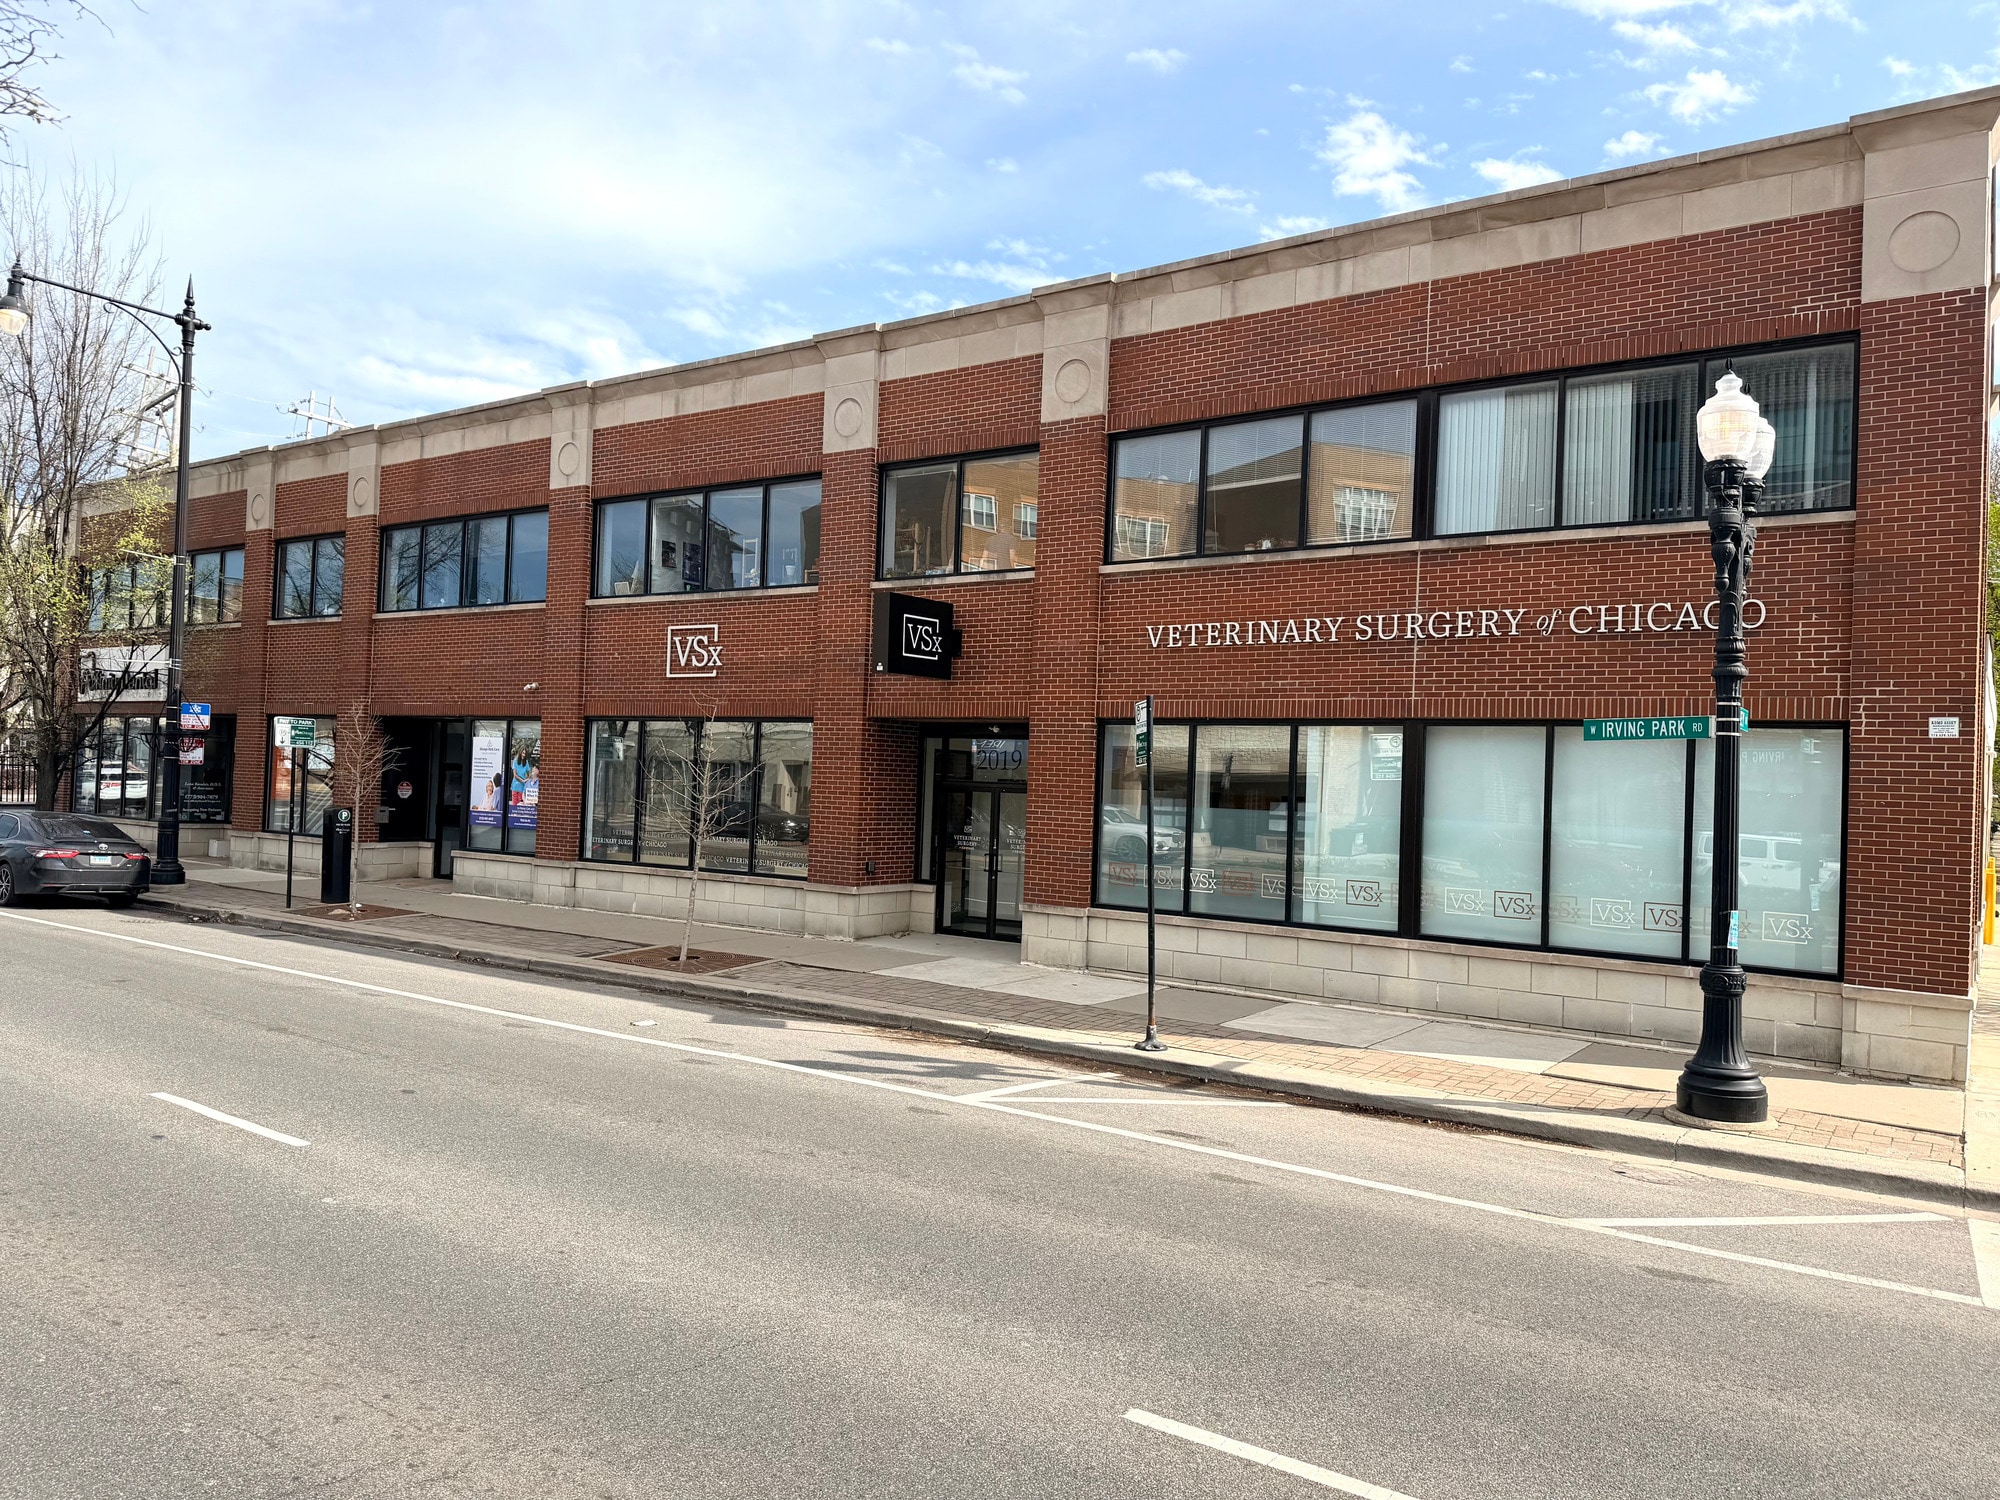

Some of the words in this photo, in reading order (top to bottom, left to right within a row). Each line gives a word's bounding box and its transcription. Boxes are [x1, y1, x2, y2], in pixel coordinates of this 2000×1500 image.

[1146, 617, 1345, 648] VETERINARY
[1355, 609, 1528, 641] SURGERY
[1536, 608, 1562, 636] of
[907, 623, 942, 653] VSx
[673, 635, 724, 667] VSx
[1590, 726, 1597, 734] W
[1602, 721, 1645, 737] IRVING
[1652, 720, 1686, 736] PARK
[1692, 723, 1703, 732] RD
[977, 750, 1022, 770] 2019
[1190, 872, 1217, 889] VSx
[1307, 882, 1338, 899] VSx
[1350, 885, 1383, 902] VSx
[1449, 892, 1486, 911] VSx
[1498, 896, 1536, 915] VSx
[1595, 903, 1635, 924] VSx
[1768, 918, 1813, 939] VSx
